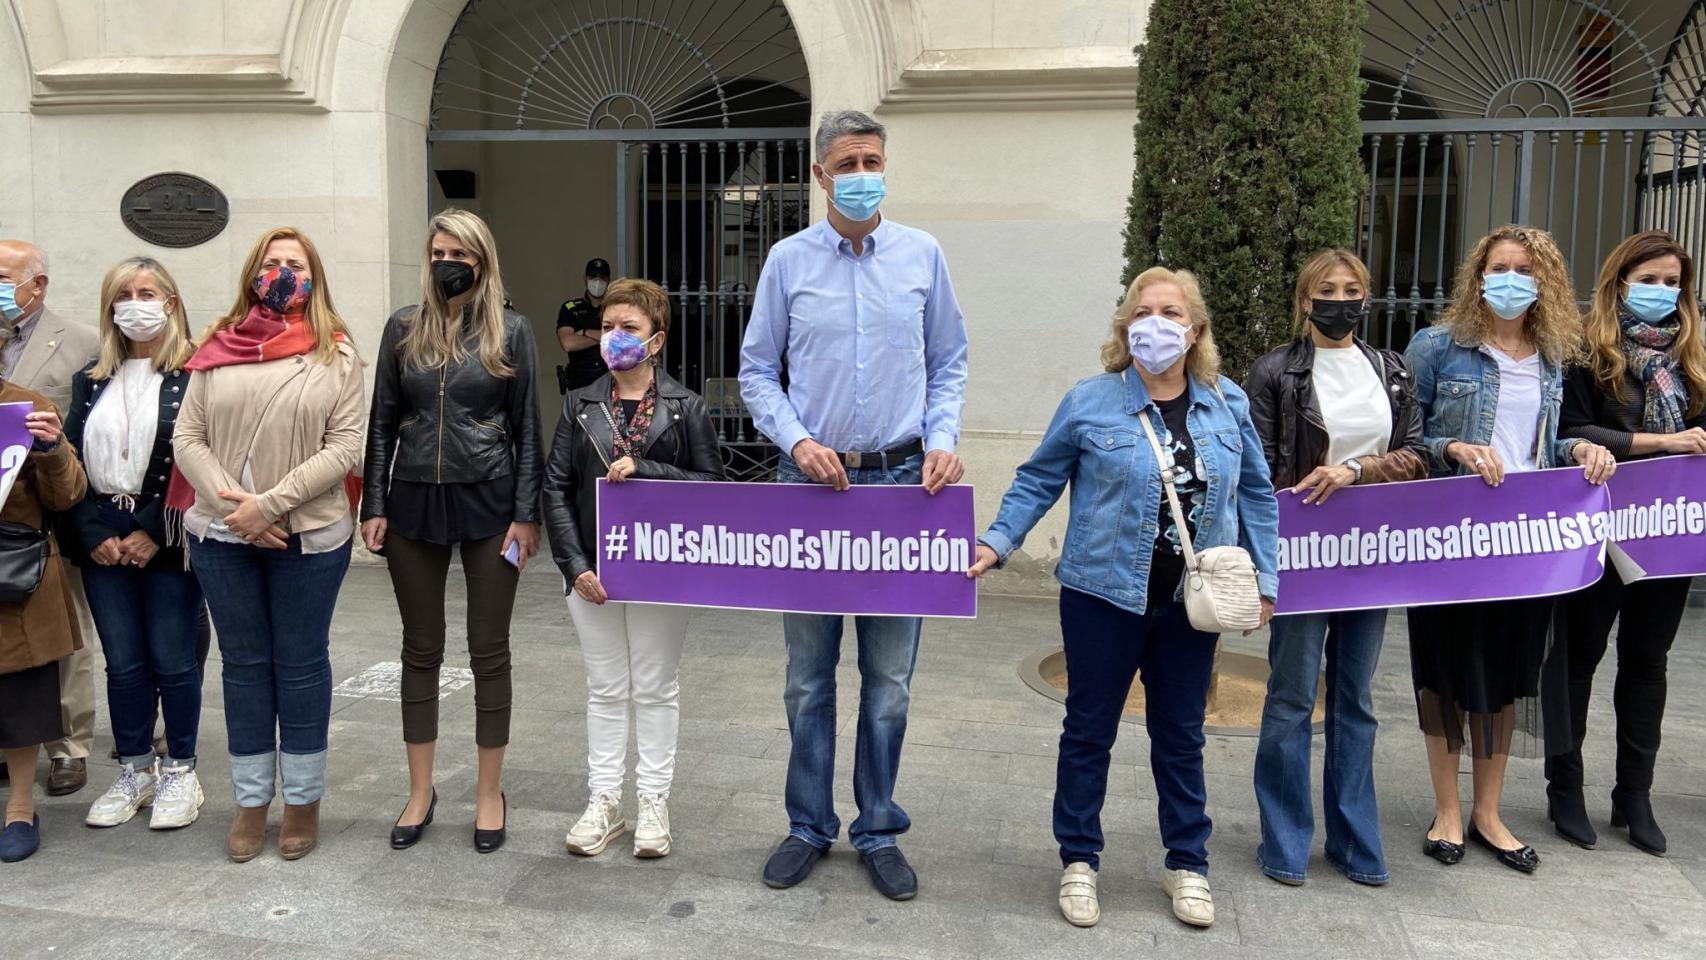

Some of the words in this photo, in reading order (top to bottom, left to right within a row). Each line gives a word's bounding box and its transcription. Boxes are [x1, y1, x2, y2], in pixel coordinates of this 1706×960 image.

[1609, 496, 1706, 542] utodefe
[605, 525, 628, 561] #
[634, 521, 969, 572] NoEsAbusoEsViolación
